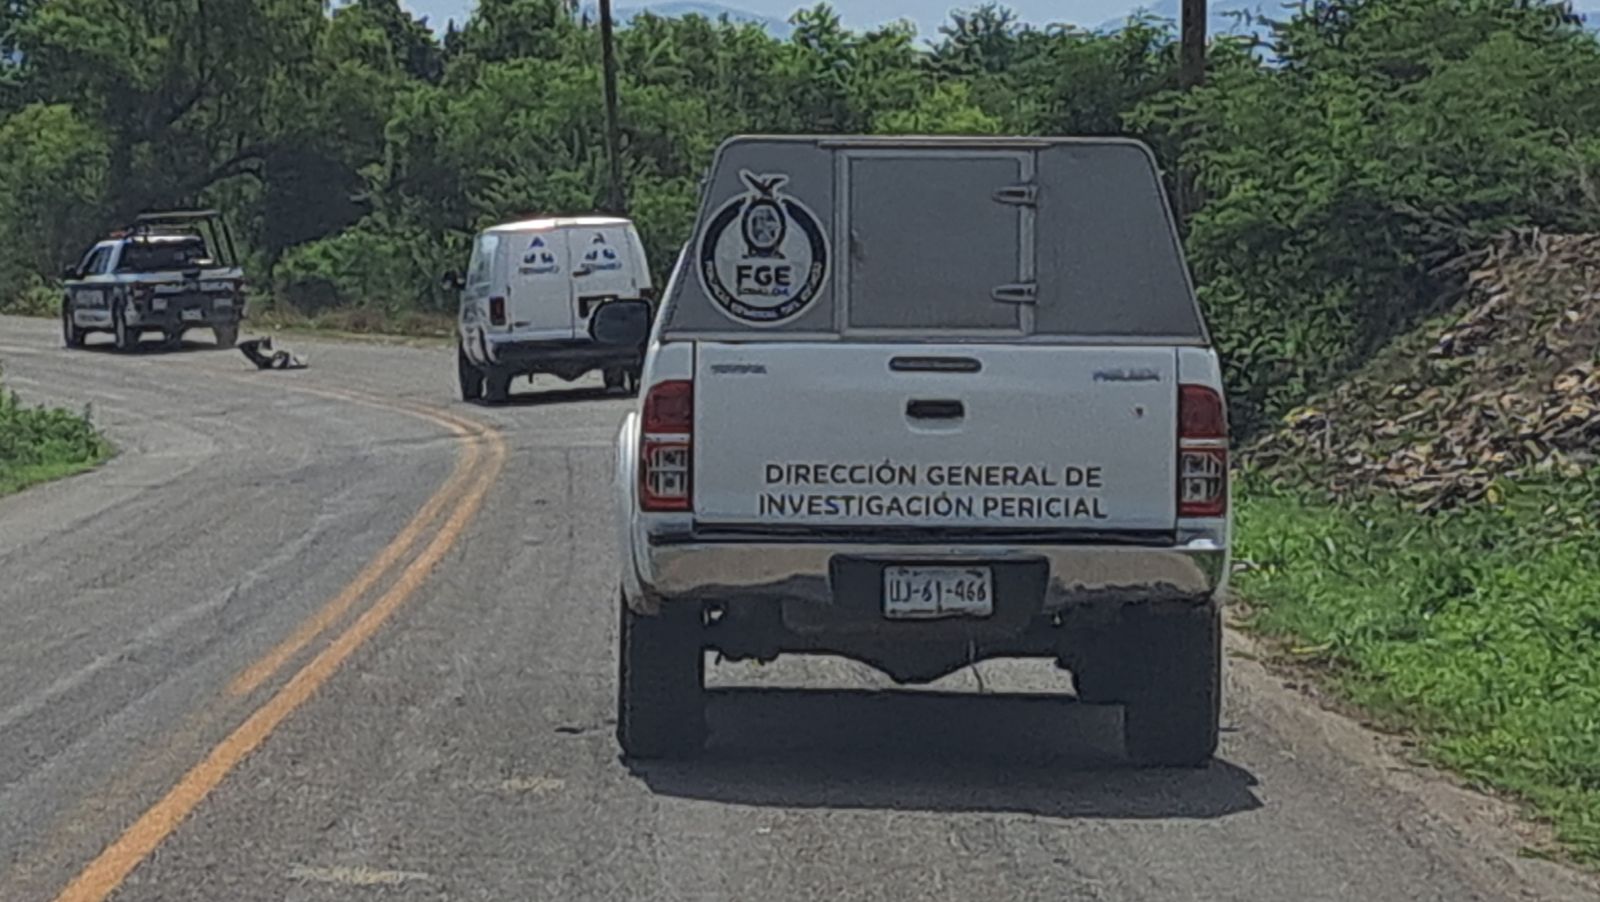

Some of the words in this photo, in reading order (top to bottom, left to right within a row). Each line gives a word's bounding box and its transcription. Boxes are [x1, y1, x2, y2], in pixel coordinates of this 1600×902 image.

[736, 265, 791, 287] FGE
[765, 459, 917, 485] DIRECCIÓN
[926, 466, 1056, 486] GENERAL
[1066, 467, 1102, 487] DE
[759, 491, 974, 517] INVESTIGACIÓN
[983, 497, 1107, 518] PERICIAL
